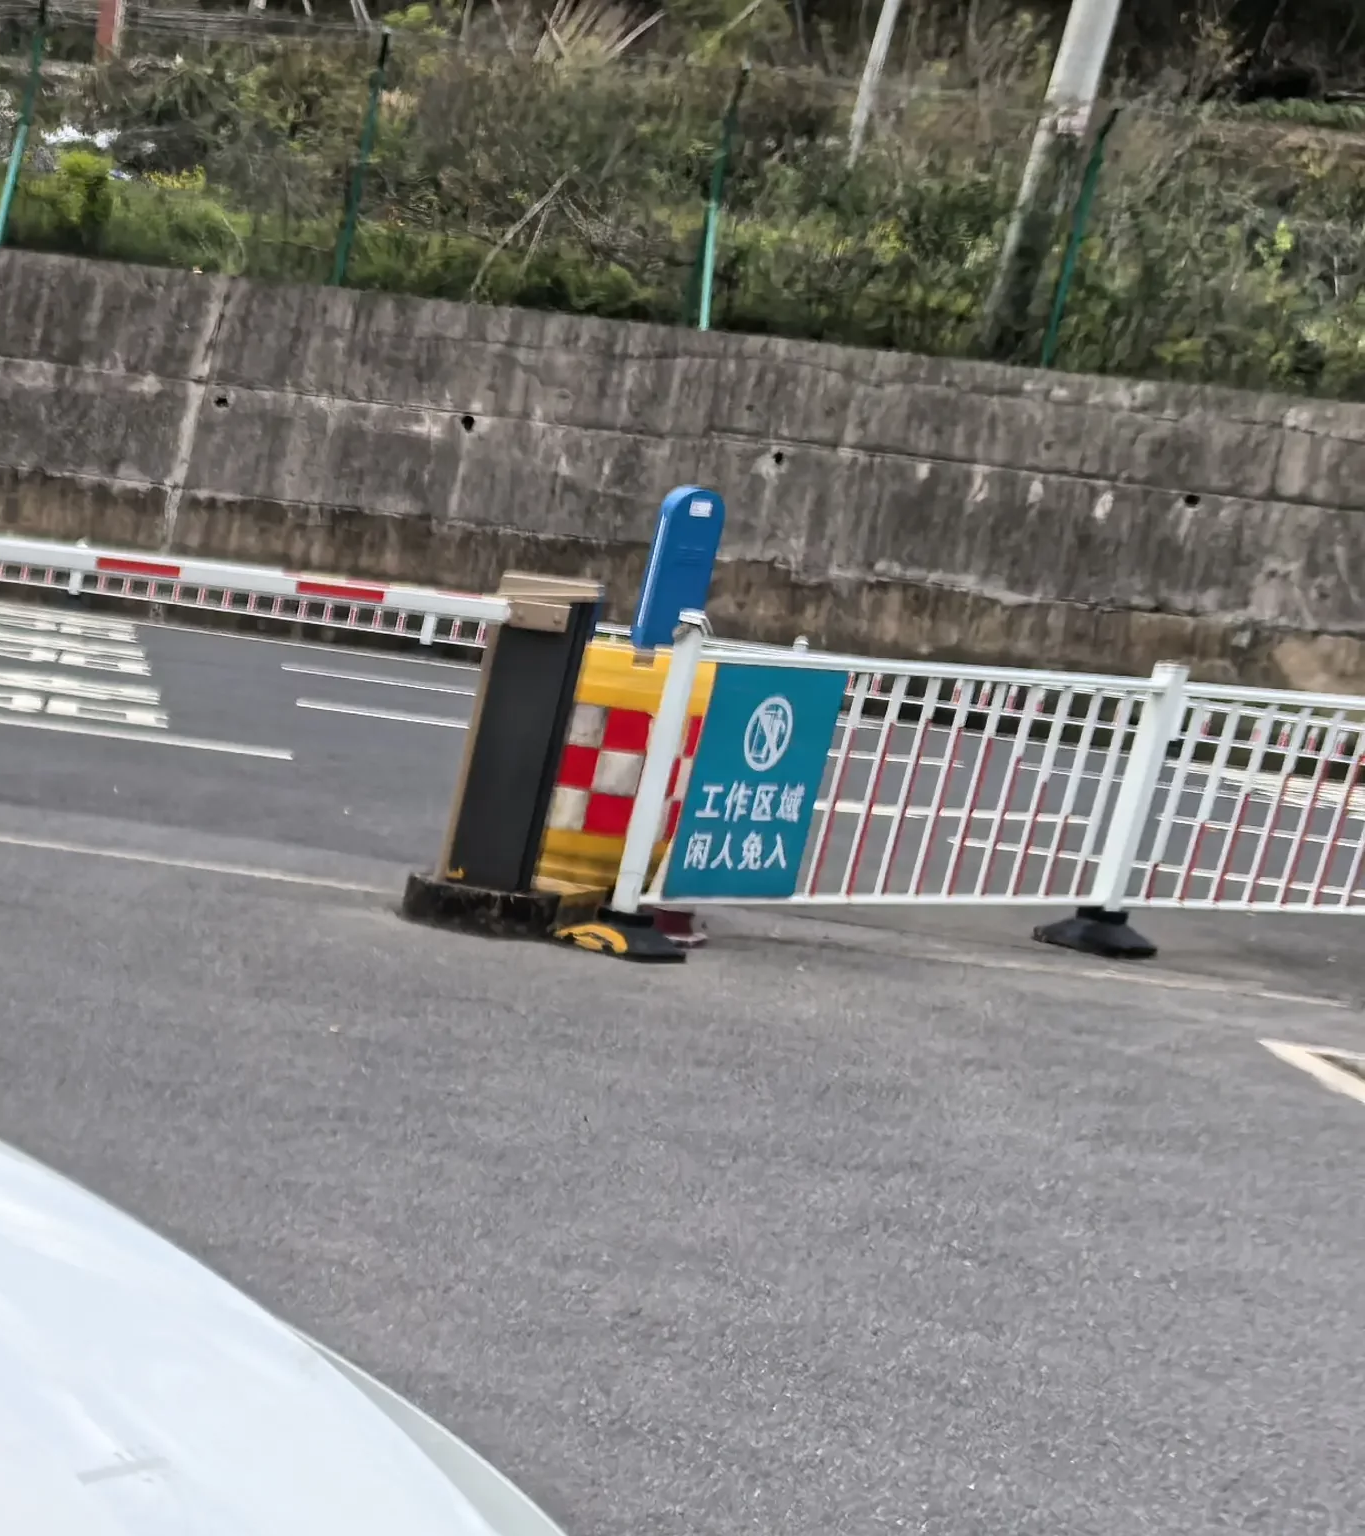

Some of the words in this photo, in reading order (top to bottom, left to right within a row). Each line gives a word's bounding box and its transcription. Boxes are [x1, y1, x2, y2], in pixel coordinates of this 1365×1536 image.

[695, 780, 805, 823] 工作区域
[683, 830, 787, 871] 闲人免入
